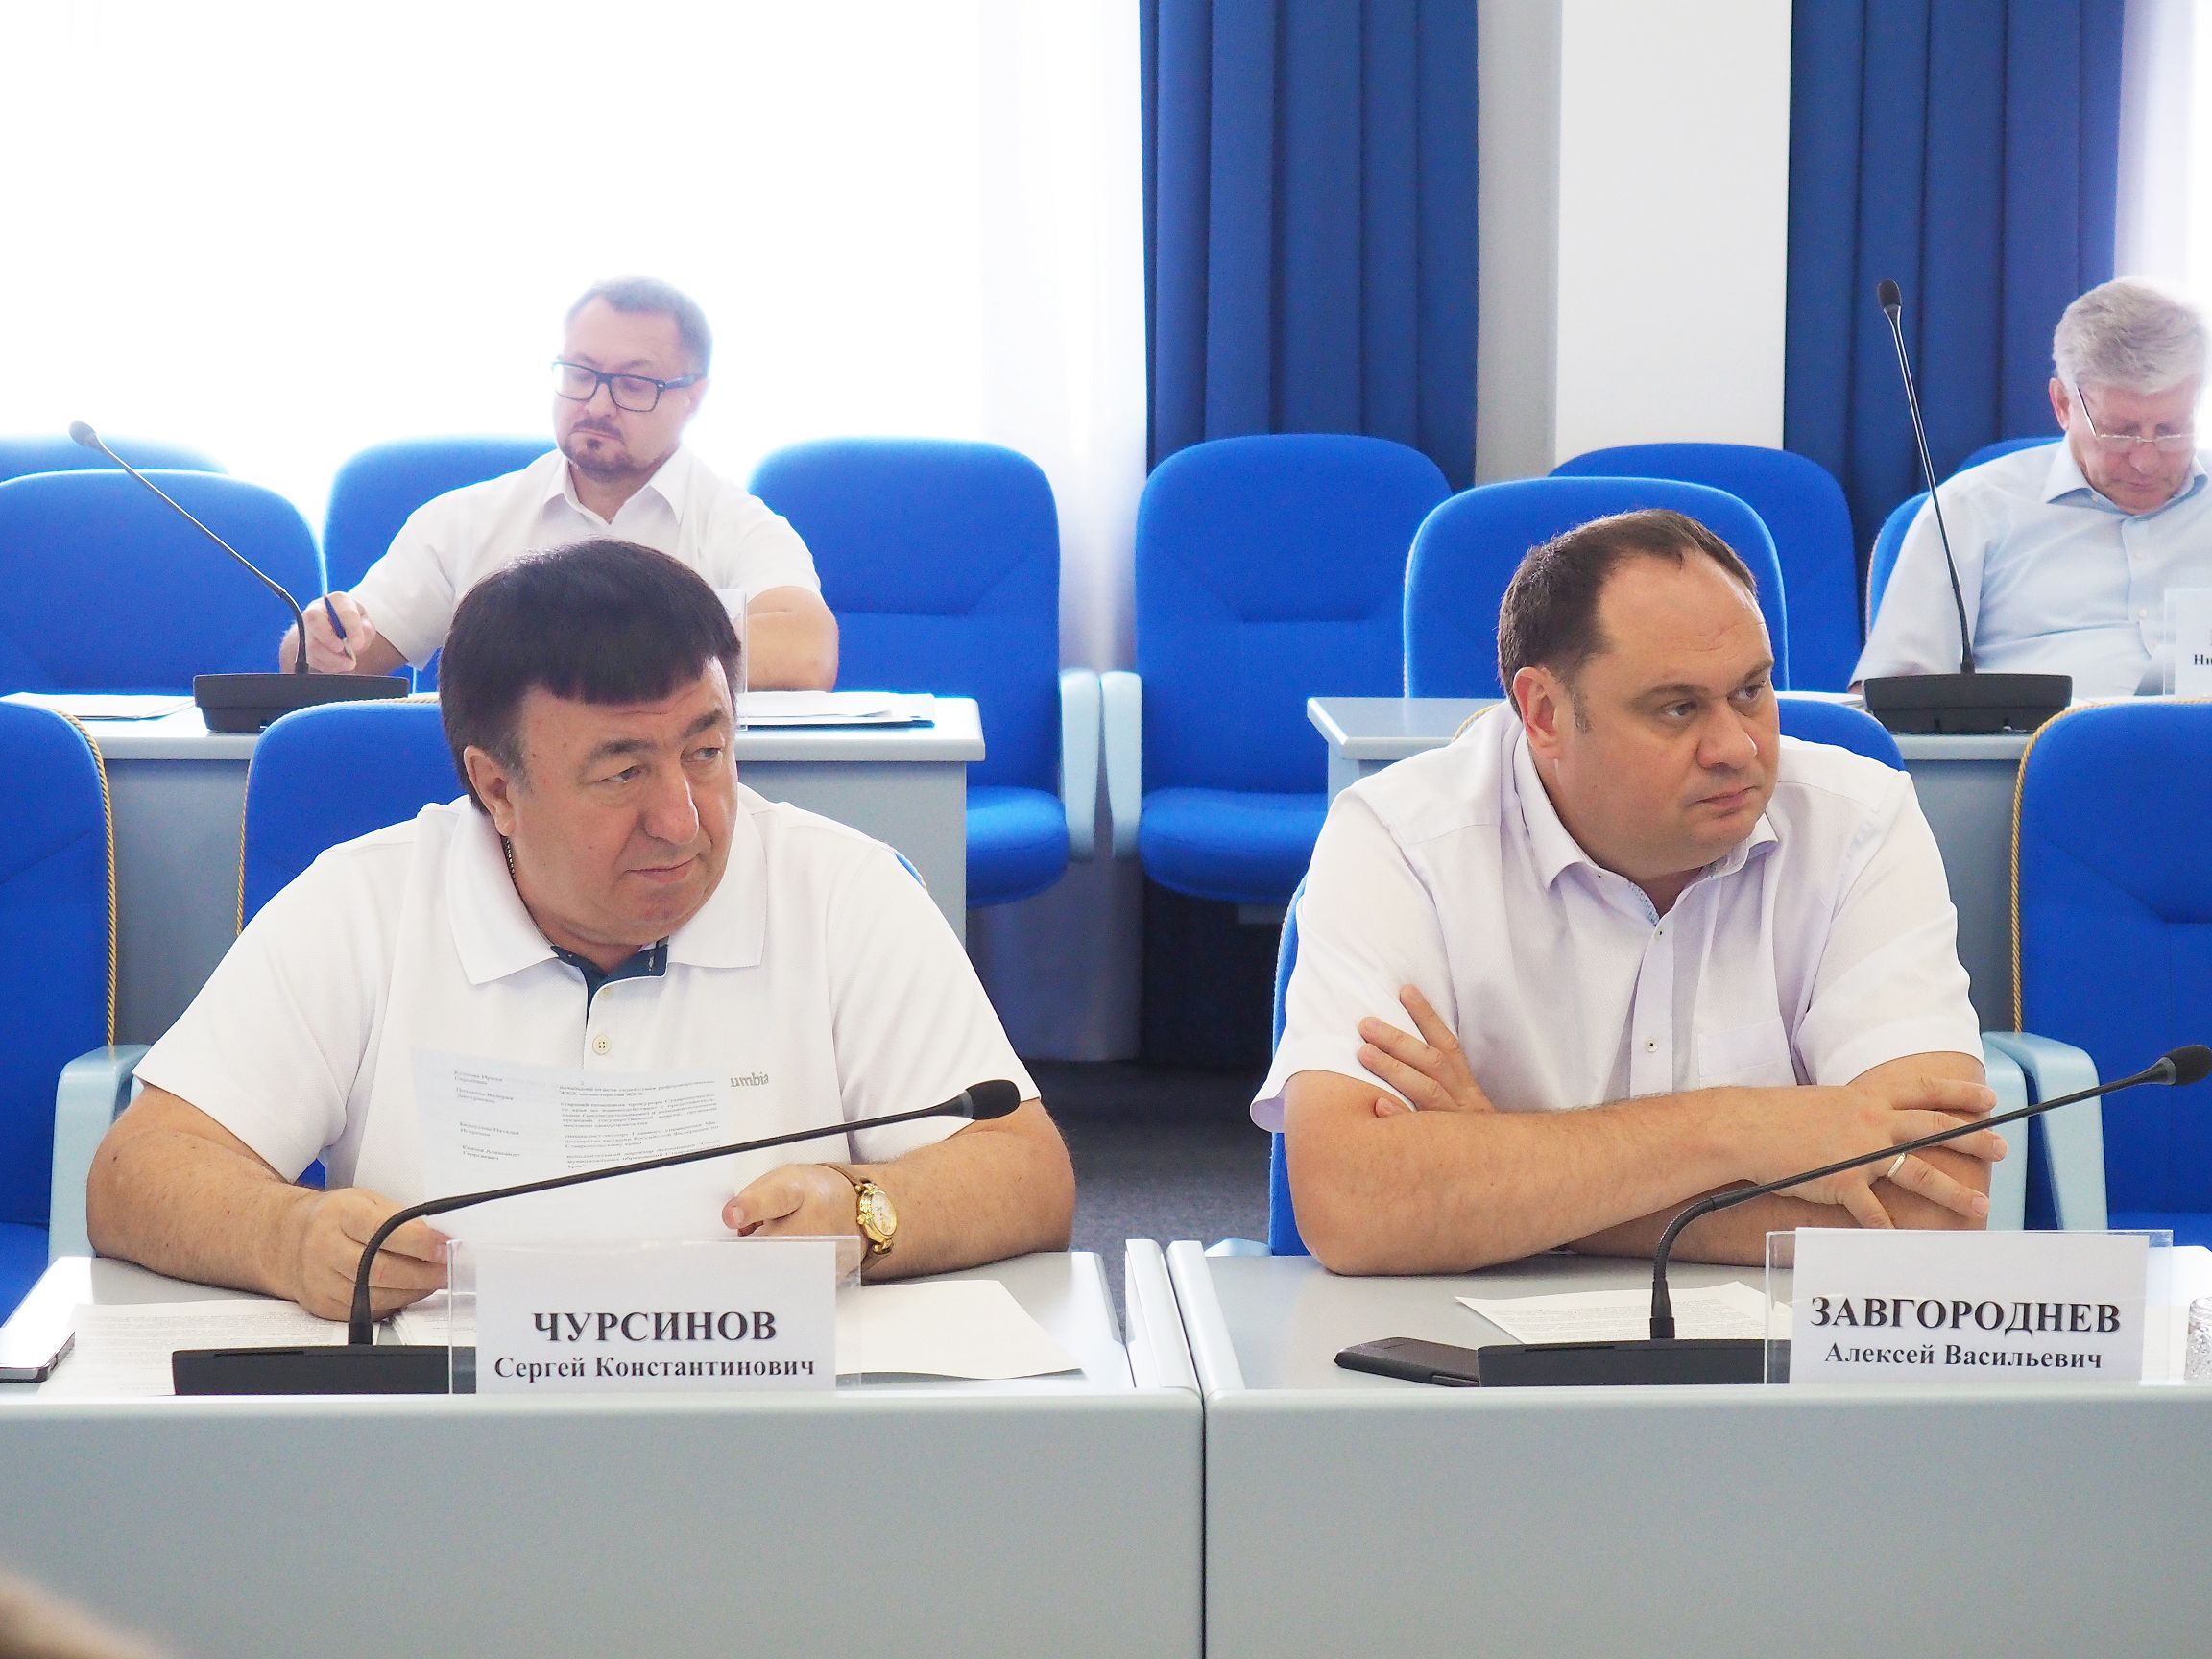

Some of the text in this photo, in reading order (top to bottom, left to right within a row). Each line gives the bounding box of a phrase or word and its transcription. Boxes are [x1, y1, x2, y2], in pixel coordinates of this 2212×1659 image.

[532, 1310, 778, 1342] ЧУРСИНОВ
[1810, 1296, 2121, 1336] ЗАВГОРОДНЕВ
[494, 1356, 815, 1383] Сергей Константинович
[1824, 1341, 2102, 1369] Алексей Васильевич
